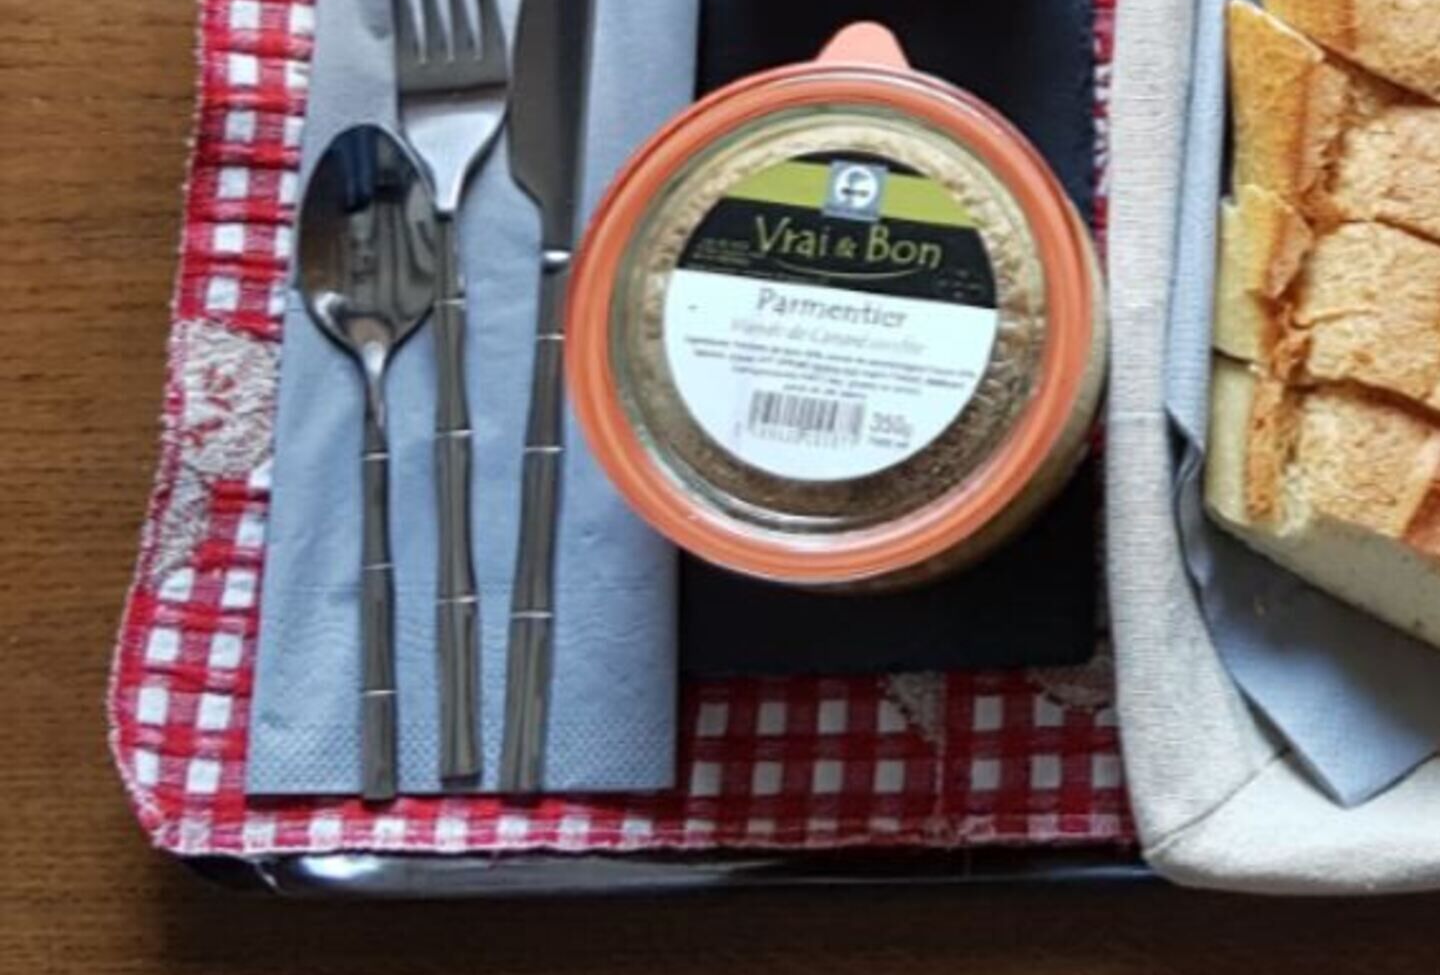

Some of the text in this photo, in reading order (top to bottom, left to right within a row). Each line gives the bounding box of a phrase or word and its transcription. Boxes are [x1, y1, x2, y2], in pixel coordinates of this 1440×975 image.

[754, 215, 831, 259] Vrai
[865, 224, 944, 270] Bon
[756, 286, 909, 329] Parmentier
